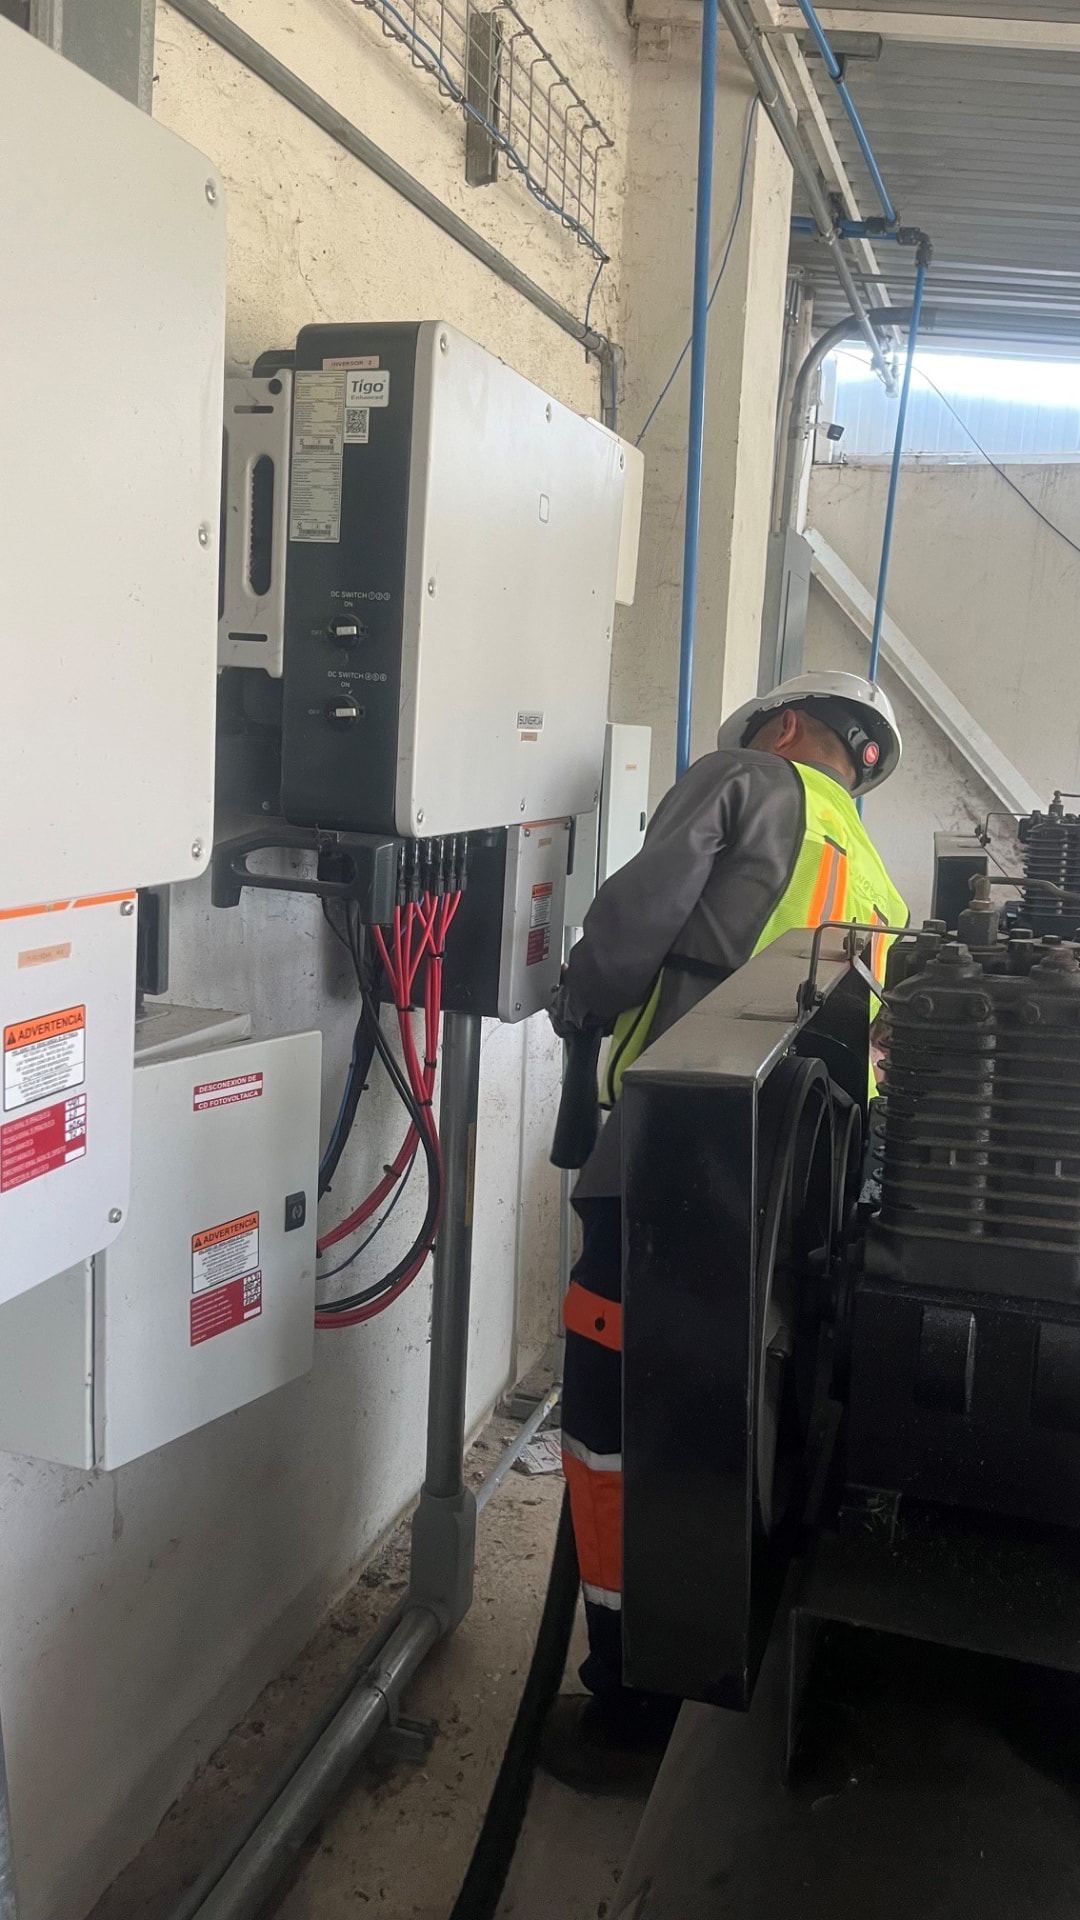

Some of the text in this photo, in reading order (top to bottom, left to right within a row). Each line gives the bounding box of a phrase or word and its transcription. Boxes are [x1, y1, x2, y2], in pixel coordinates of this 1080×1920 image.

[351, 379, 384, 395] Tigo
[330, 590, 340, 599] DC
[341, 591, 367, 600] SWITCH
[327, 670, 337, 679] DC
[338, 671, 364, 680] SWITCH
[340, 681, 350, 689] ON
[18, 1012, 83, 1042] ADVERTENCIA
[198, 1074, 257, 1094] DESCONEXION DE
[198, 1090, 259, 1110] CD FOTOVOLTAICA
[202, 1216, 257, 1244] ADVERTENCIA
